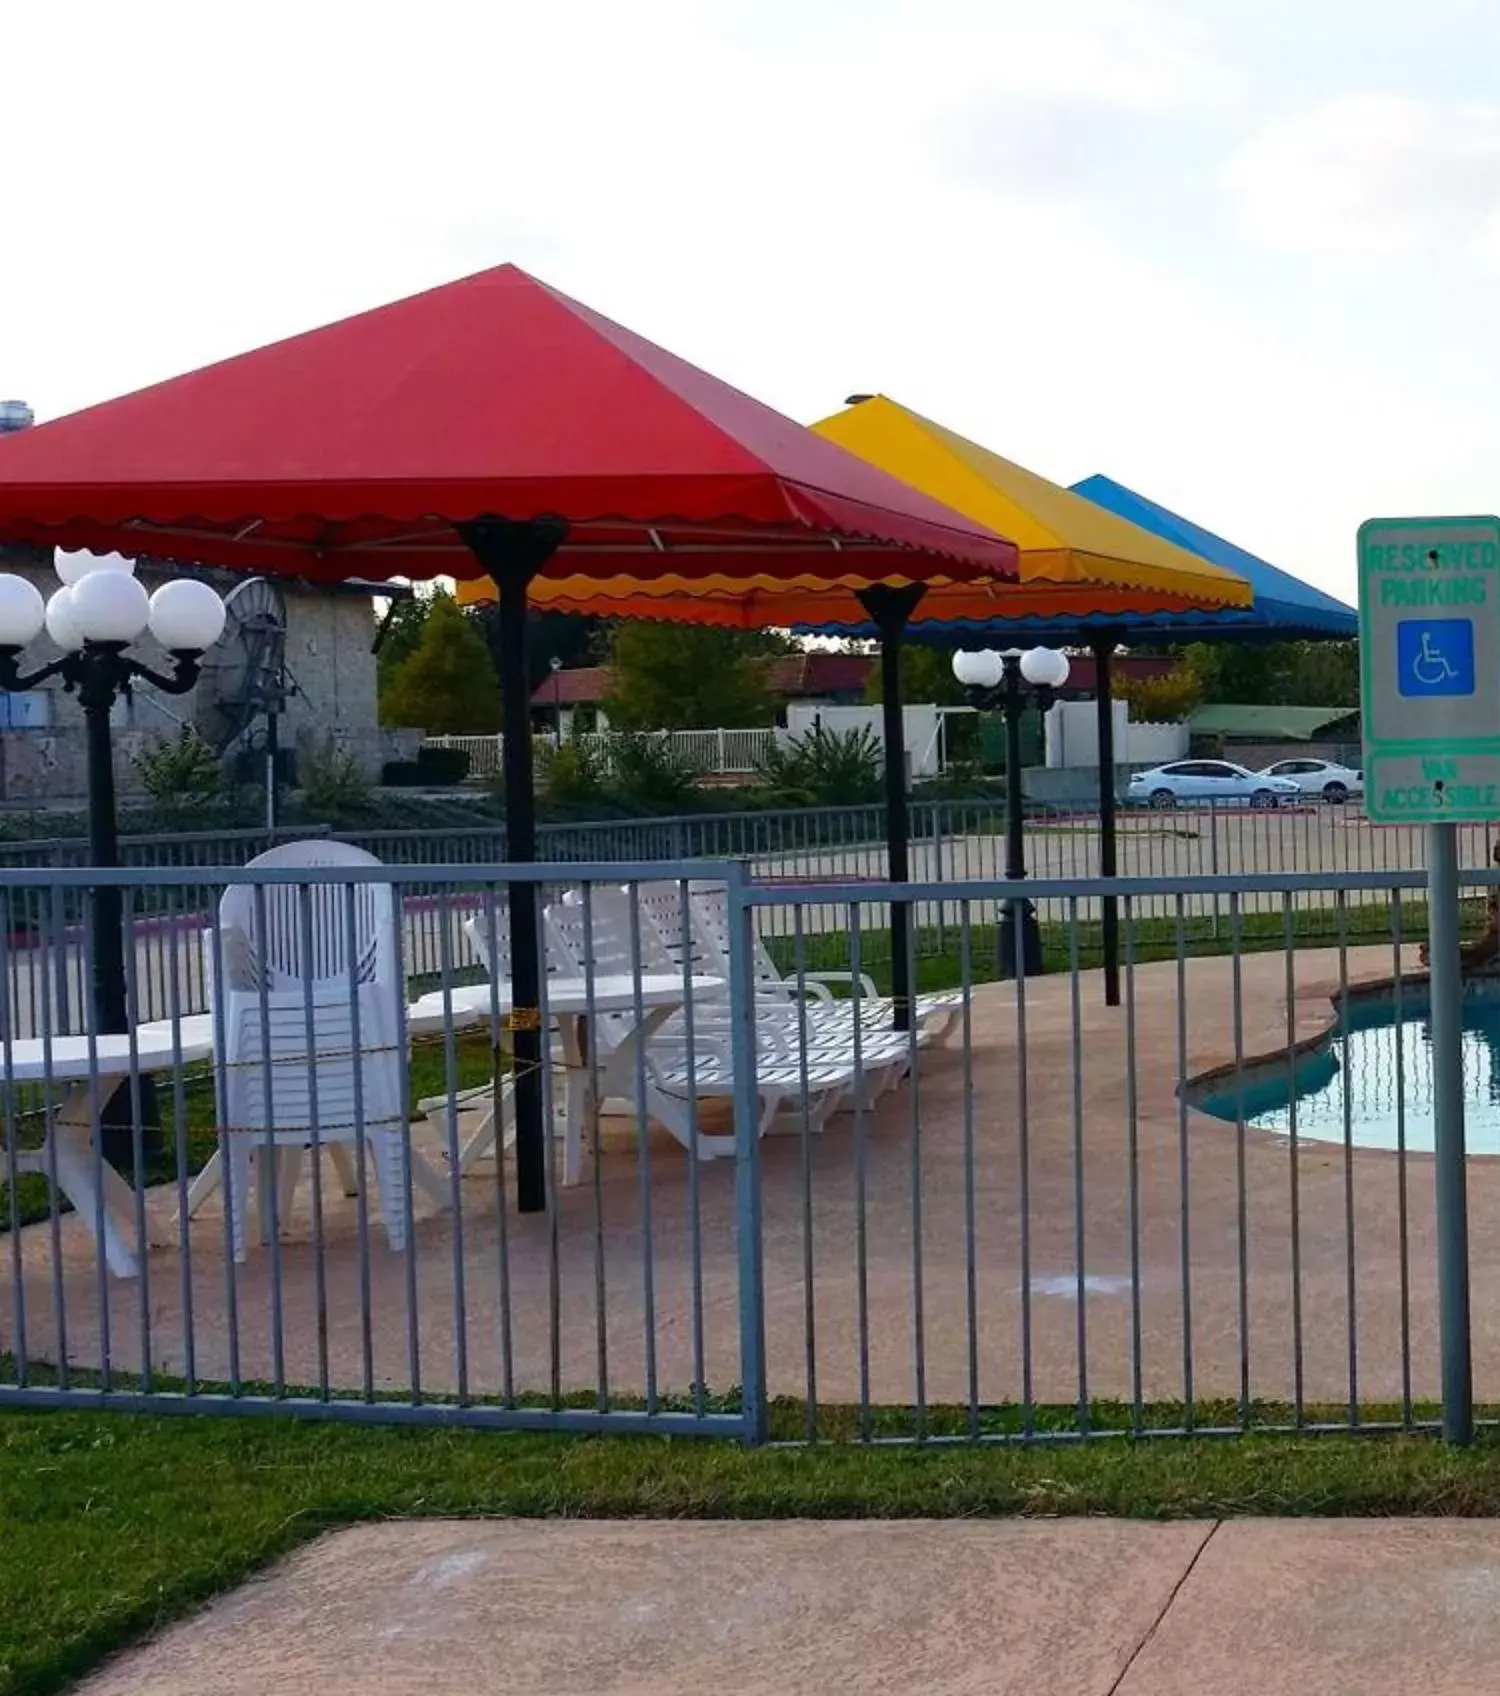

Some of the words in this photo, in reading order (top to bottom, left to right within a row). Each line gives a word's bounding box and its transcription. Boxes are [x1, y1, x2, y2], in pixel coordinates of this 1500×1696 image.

[1368, 541, 1496, 571] RESERVED
[1381, 576, 1487, 607] PARKING
[1421, 758, 1458, 780] VAN
[1382, 785, 1499, 809] ACCESSIBLE
